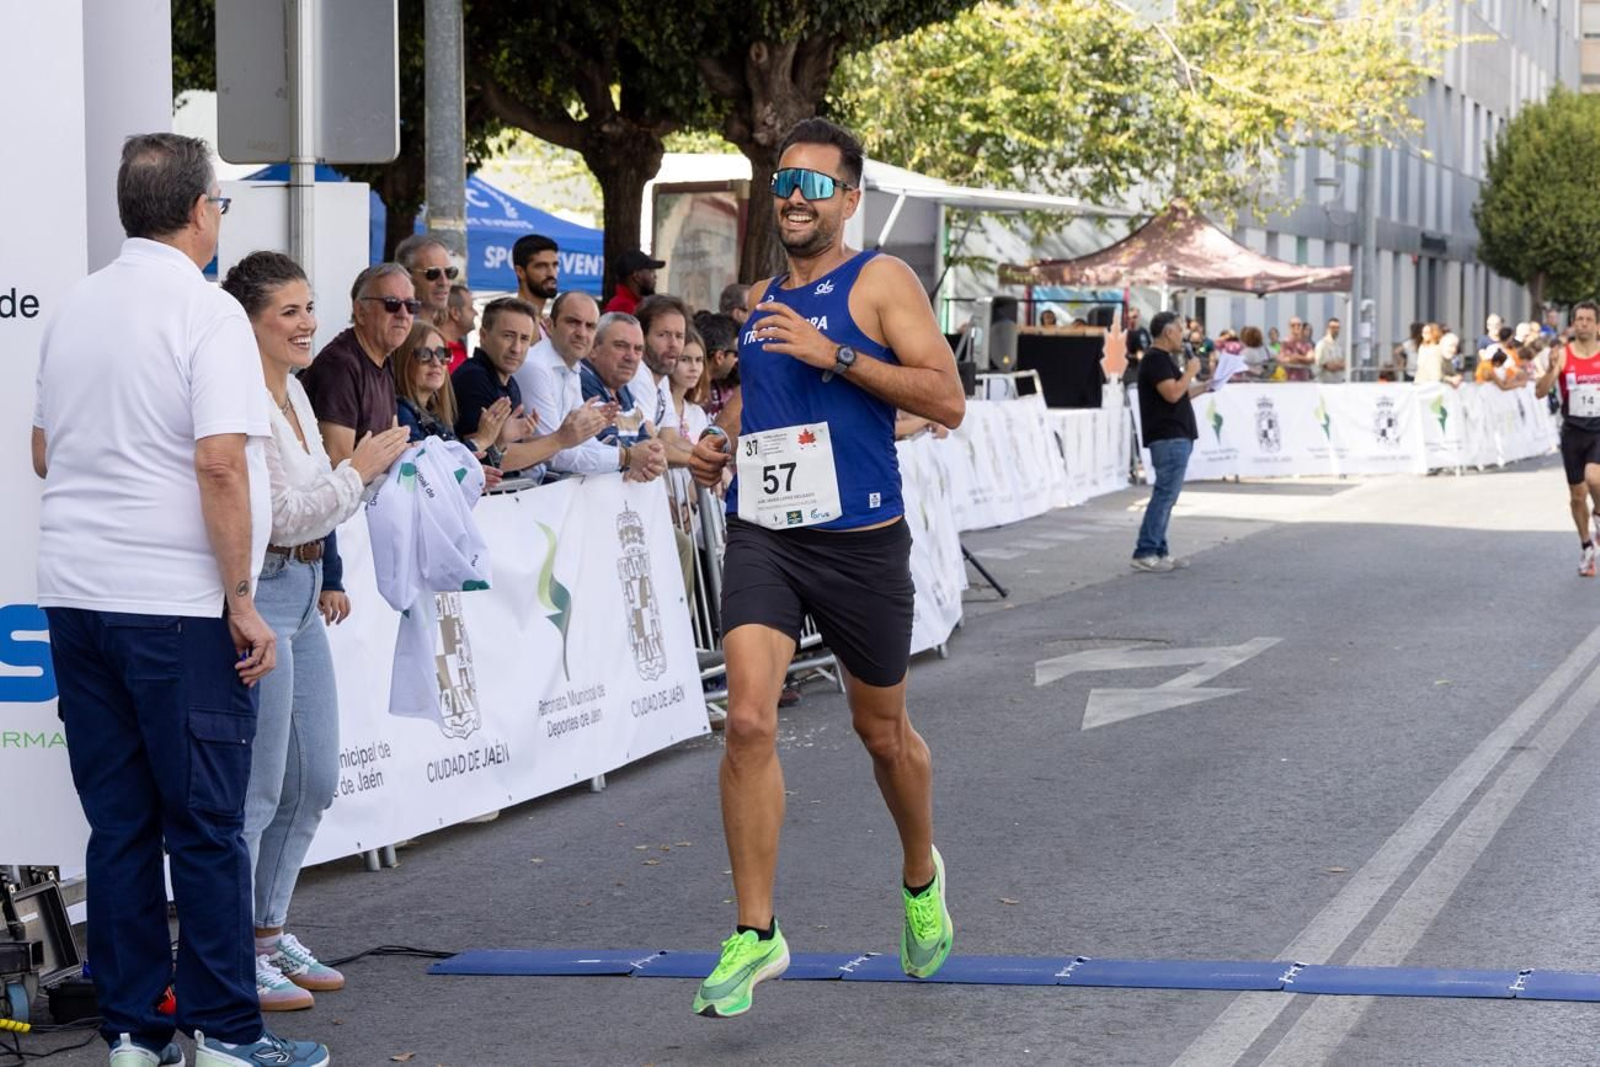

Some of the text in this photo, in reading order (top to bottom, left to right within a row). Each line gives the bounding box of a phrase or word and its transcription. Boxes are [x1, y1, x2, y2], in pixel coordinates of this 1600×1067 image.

[0, 287, 40, 318] de
[1582, 395, 1595, 405] 14
[746, 439, 759, 457] 37
[762, 462, 797, 495] 57
[630, 696, 658, 718] CIUDAD
[658, 689, 668, 709] DE
[580, 711, 590, 728] de
[2, 731, 68, 748] RMA
[379, 741, 392, 759] de
[426, 739, 511, 783] CIUDAD DE JAÉN
[340, 775, 355, 796] de
[357, 767, 385, 793] Jaén
